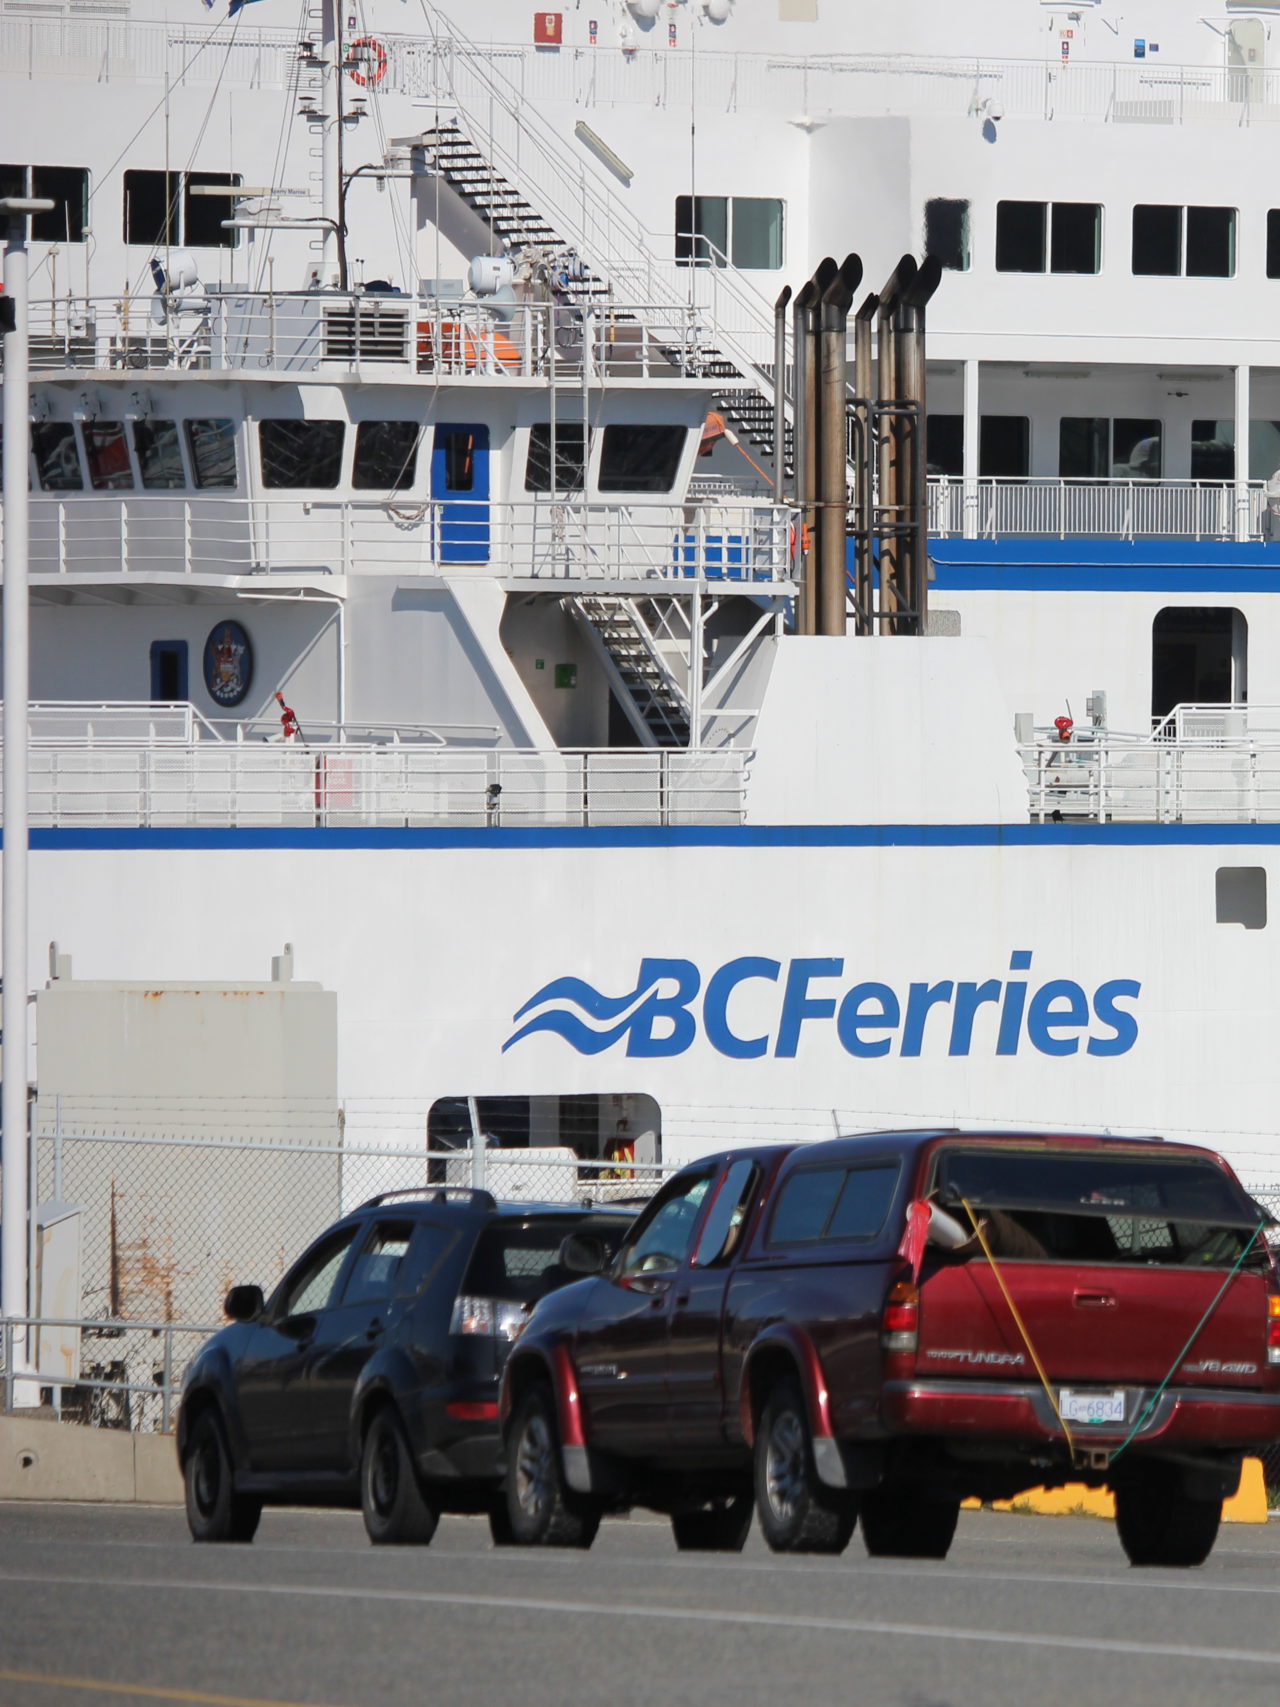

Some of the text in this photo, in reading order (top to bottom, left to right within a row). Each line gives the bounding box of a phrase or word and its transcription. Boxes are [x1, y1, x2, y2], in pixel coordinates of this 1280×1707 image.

[957, 1351, 1025, 1365] TUNDRA
[1199, 1360, 1220, 1372] V8
[1221, 1362, 1257, 1374] 4WD
[1087, 1400, 1122, 1418] 6834
